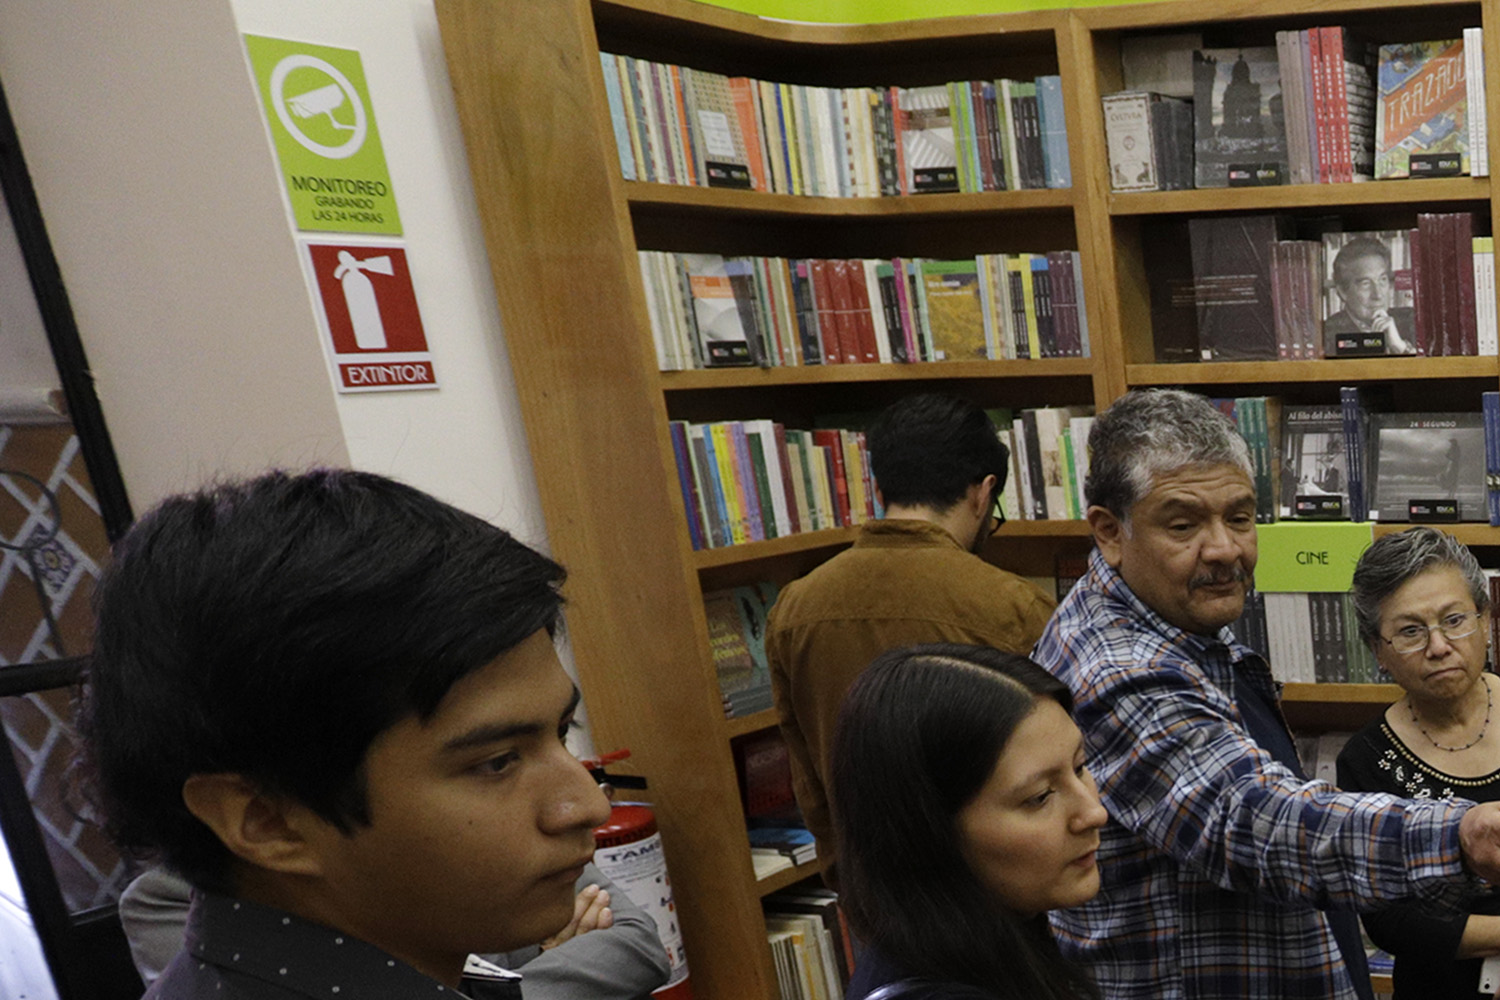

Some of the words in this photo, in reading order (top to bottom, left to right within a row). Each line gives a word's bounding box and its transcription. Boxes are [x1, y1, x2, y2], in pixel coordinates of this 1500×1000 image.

[291, 175, 387, 197] MONITOREO
[314, 195, 375, 209] GRABANDO
[313, 210, 332, 221] LAS
[335, 211, 347, 222] 24
[350, 211, 384, 224] HORAS
[347, 364, 429, 384] EXTINTOR
[1296, 551, 1329, 565] CINE
